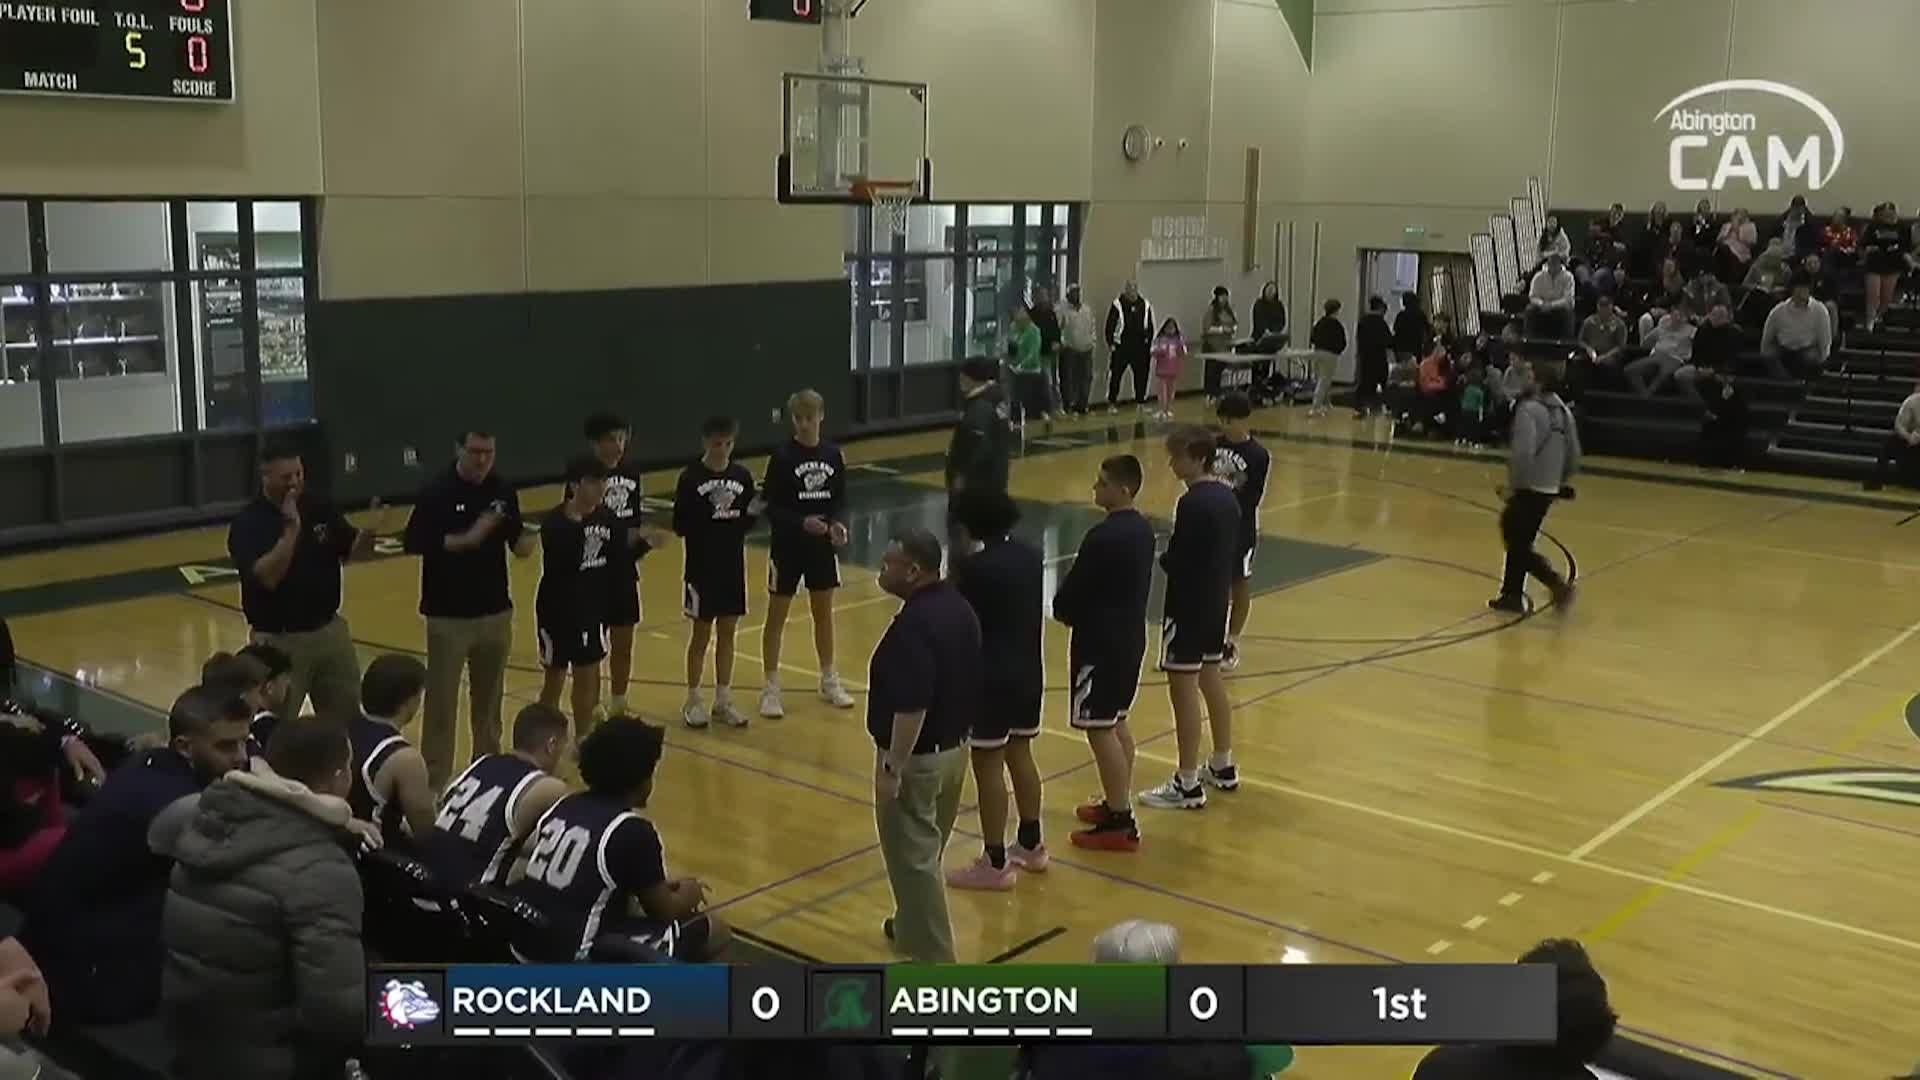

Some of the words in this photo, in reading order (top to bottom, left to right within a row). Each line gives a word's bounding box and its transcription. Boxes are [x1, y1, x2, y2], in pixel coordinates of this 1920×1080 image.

[0, 3, 56, 22] PLAYER
[61, 8, 100, 26] FOUL
[114, 12, 153, 29] T.O.L.
[169, 16, 213, 34] FOULS
[125, 32, 146, 68] 5
[187, 36, 208, 73] 0
[24, 71, 77, 90] MATCH
[173, 79, 216, 96] SCORE
[434, 776, 504, 842] 24
[526, 817, 591, 890] 20
